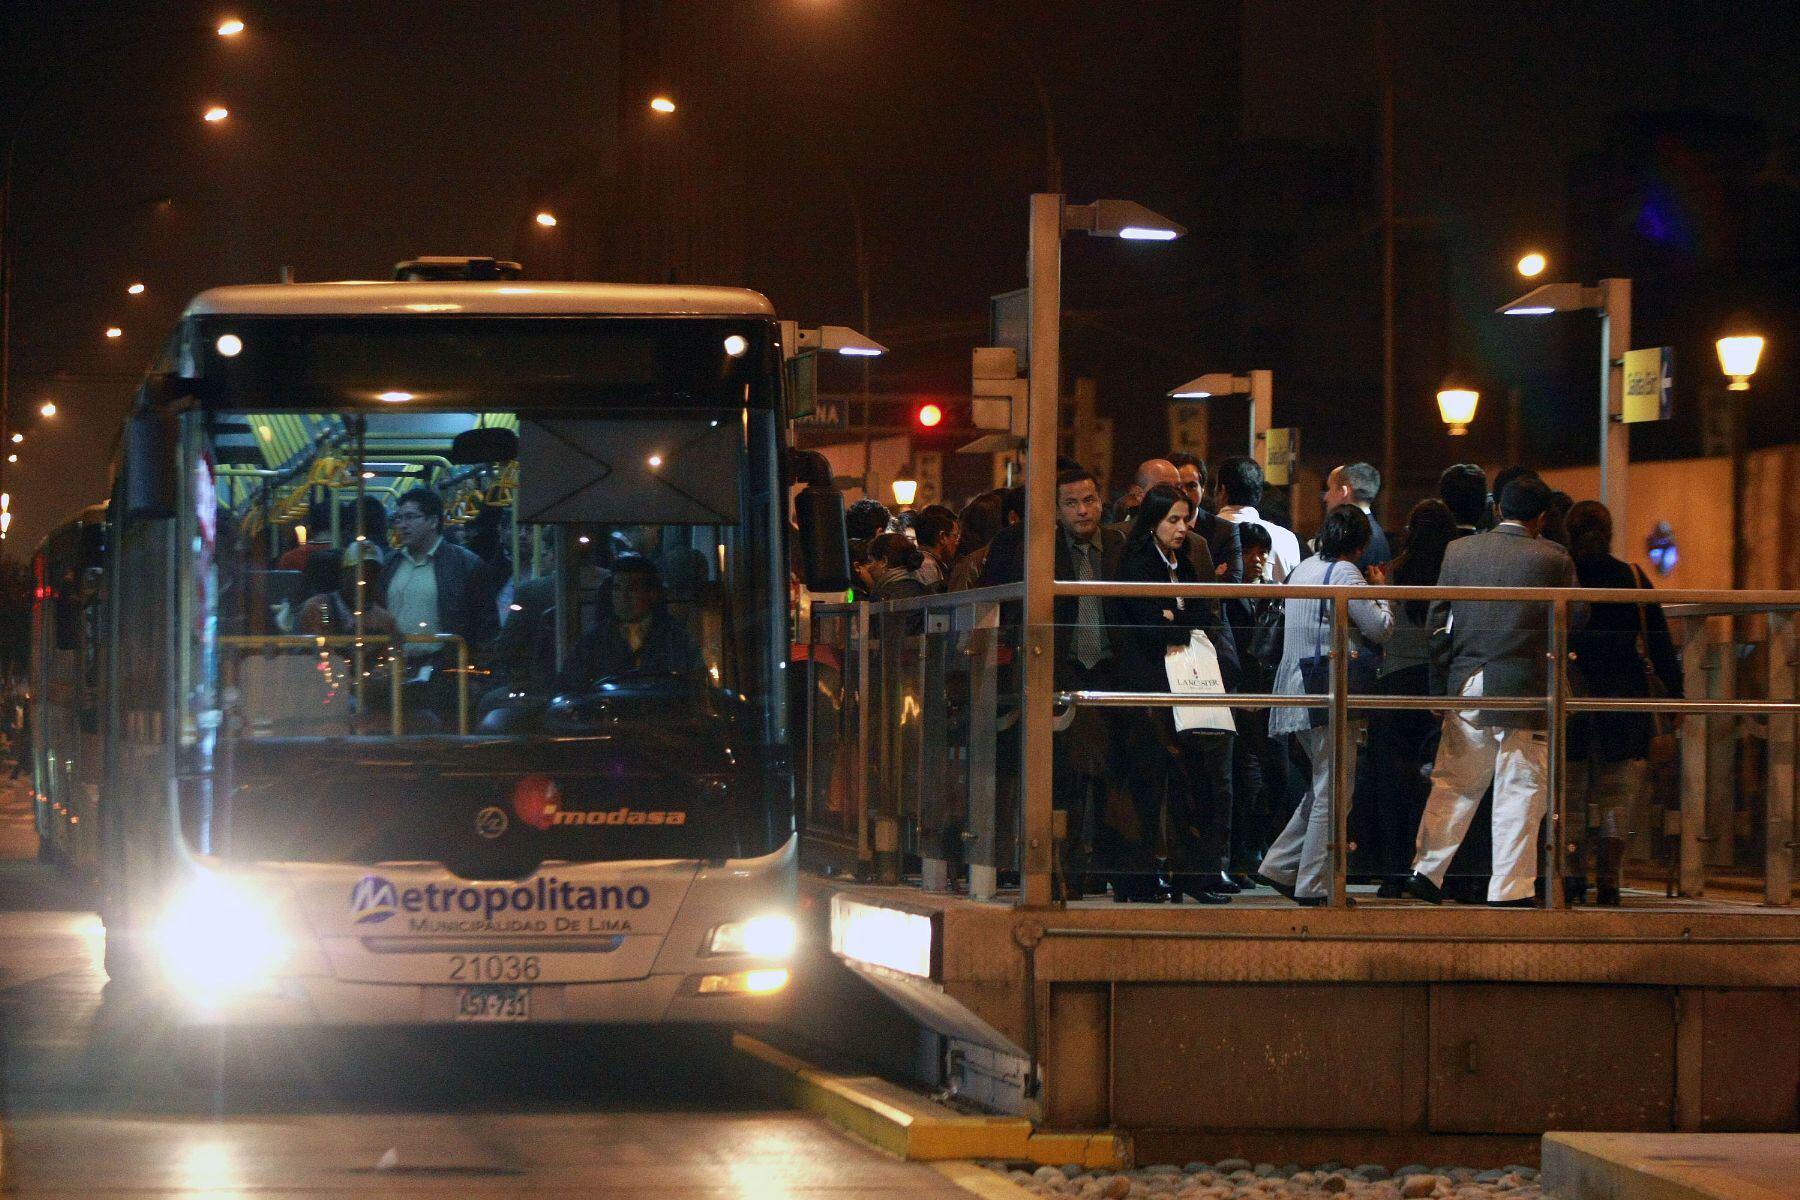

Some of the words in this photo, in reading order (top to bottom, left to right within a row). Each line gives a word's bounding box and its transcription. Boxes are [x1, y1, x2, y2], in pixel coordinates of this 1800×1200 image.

[551, 807, 687, 826] modasa
[352, 876, 651, 923] Metropolitano
[450, 955, 541, 981] 21036
